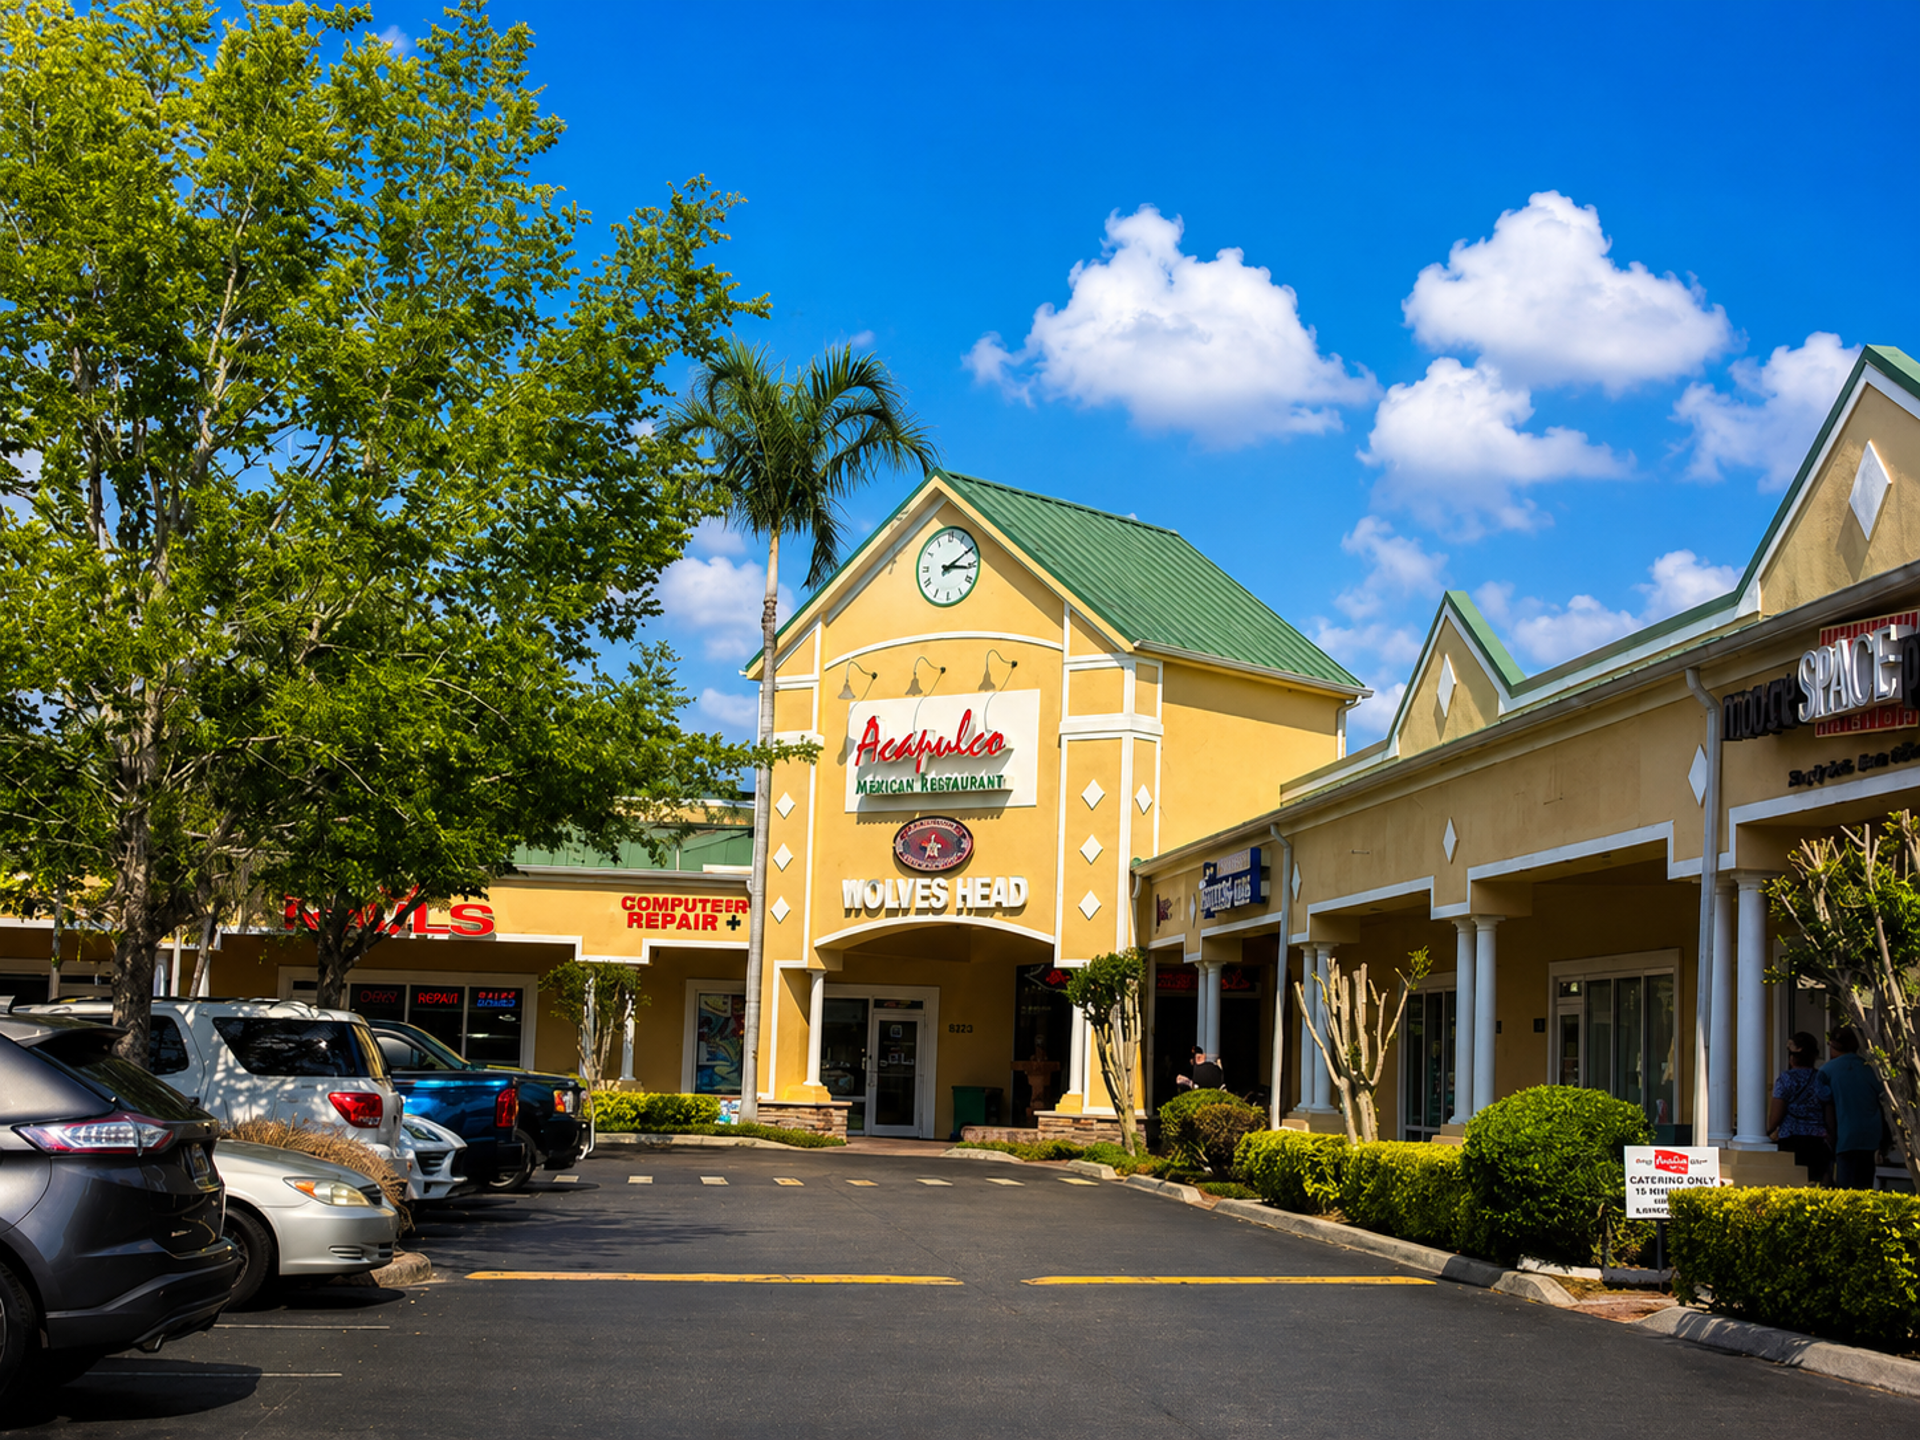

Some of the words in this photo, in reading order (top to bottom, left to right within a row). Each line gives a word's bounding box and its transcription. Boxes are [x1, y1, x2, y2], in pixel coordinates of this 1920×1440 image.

[1798, 624, 1902, 722] SPACE
[855, 709, 1006, 774] Acapulco
[856, 777, 915, 795] MEXICAN
[921, 773, 1004, 792] RESTAURANT
[842, 877, 949, 910] WOLVES
[956, 876, 1029, 908] HEAD
[284, 893, 495, 936] NLS
[627, 912, 718, 931] REPAIR
[1687, 1176, 1716, 1185] ONLY
